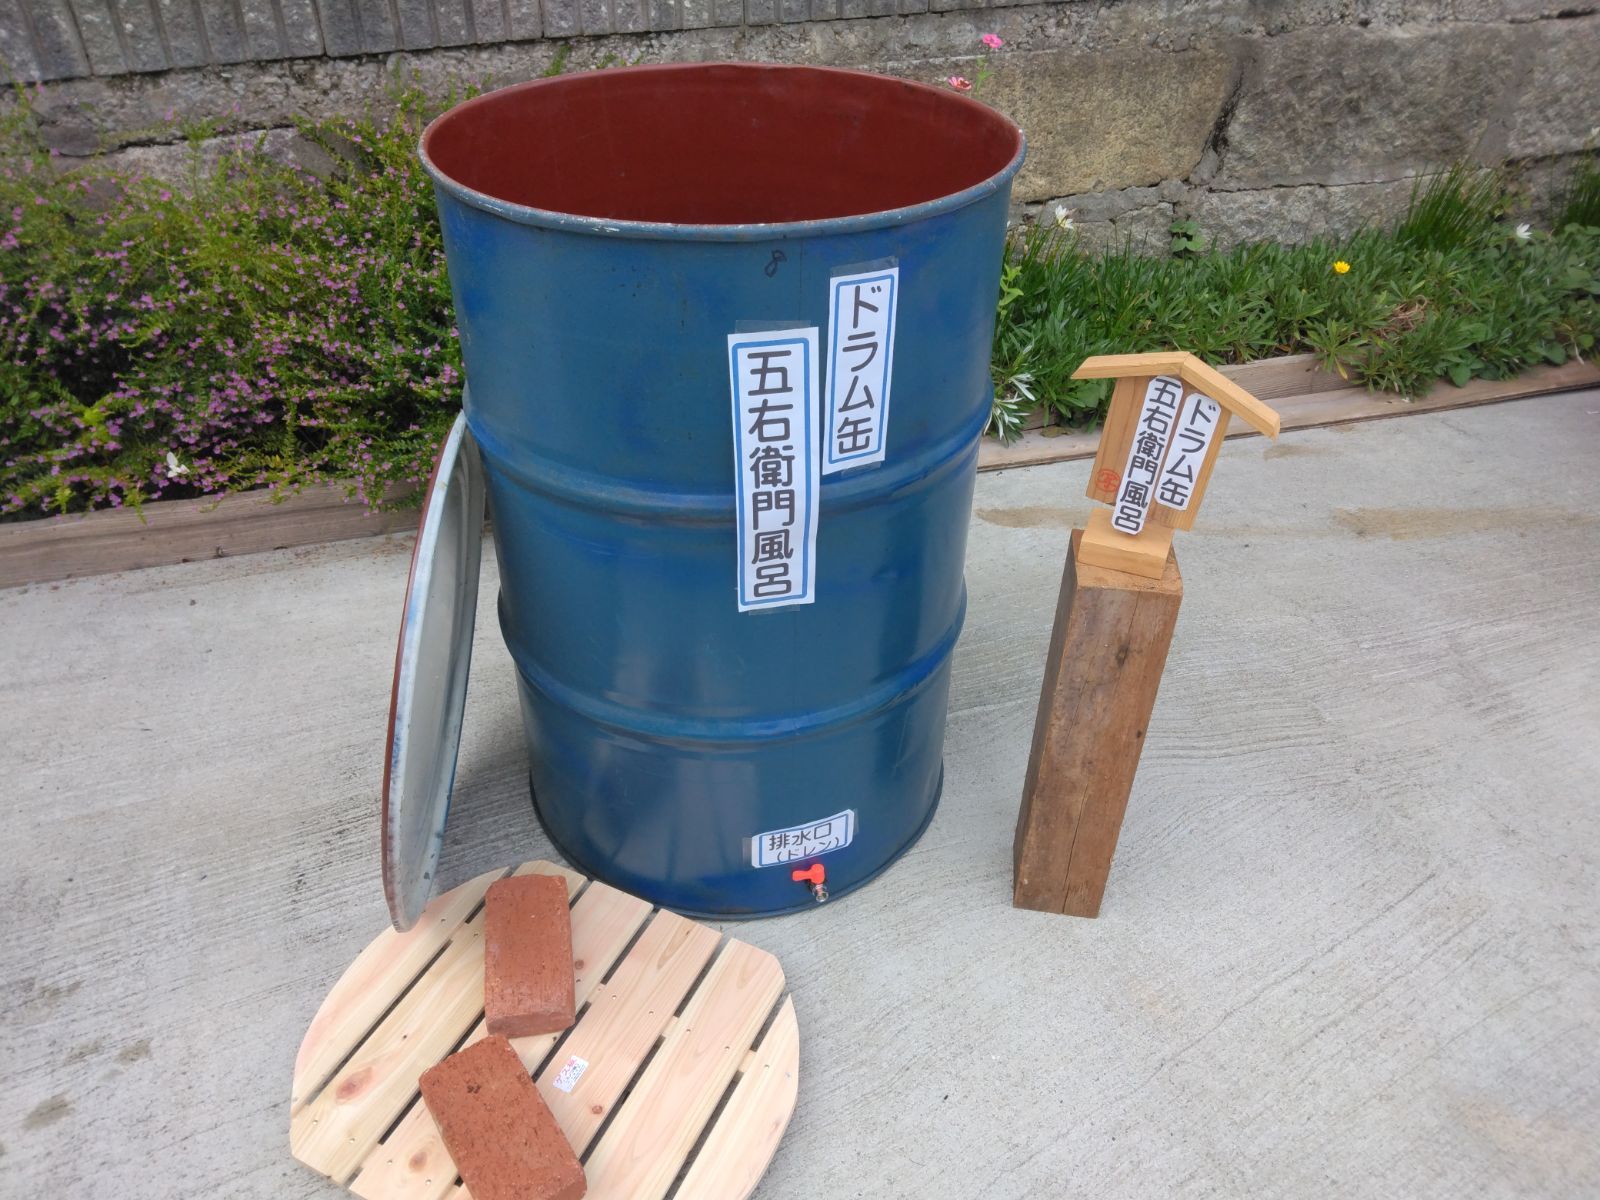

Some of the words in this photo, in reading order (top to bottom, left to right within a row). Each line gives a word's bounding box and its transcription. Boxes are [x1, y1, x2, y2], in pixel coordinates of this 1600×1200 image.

[837, 284, 882, 455] ドラム缶
[747, 349, 796, 599] 五右衛門風呂
[1114, 378, 1182, 532] 五右衛門風呂
[1160, 399, 1216, 507] ドラム缶
[769, 822, 832, 851] 排水口
